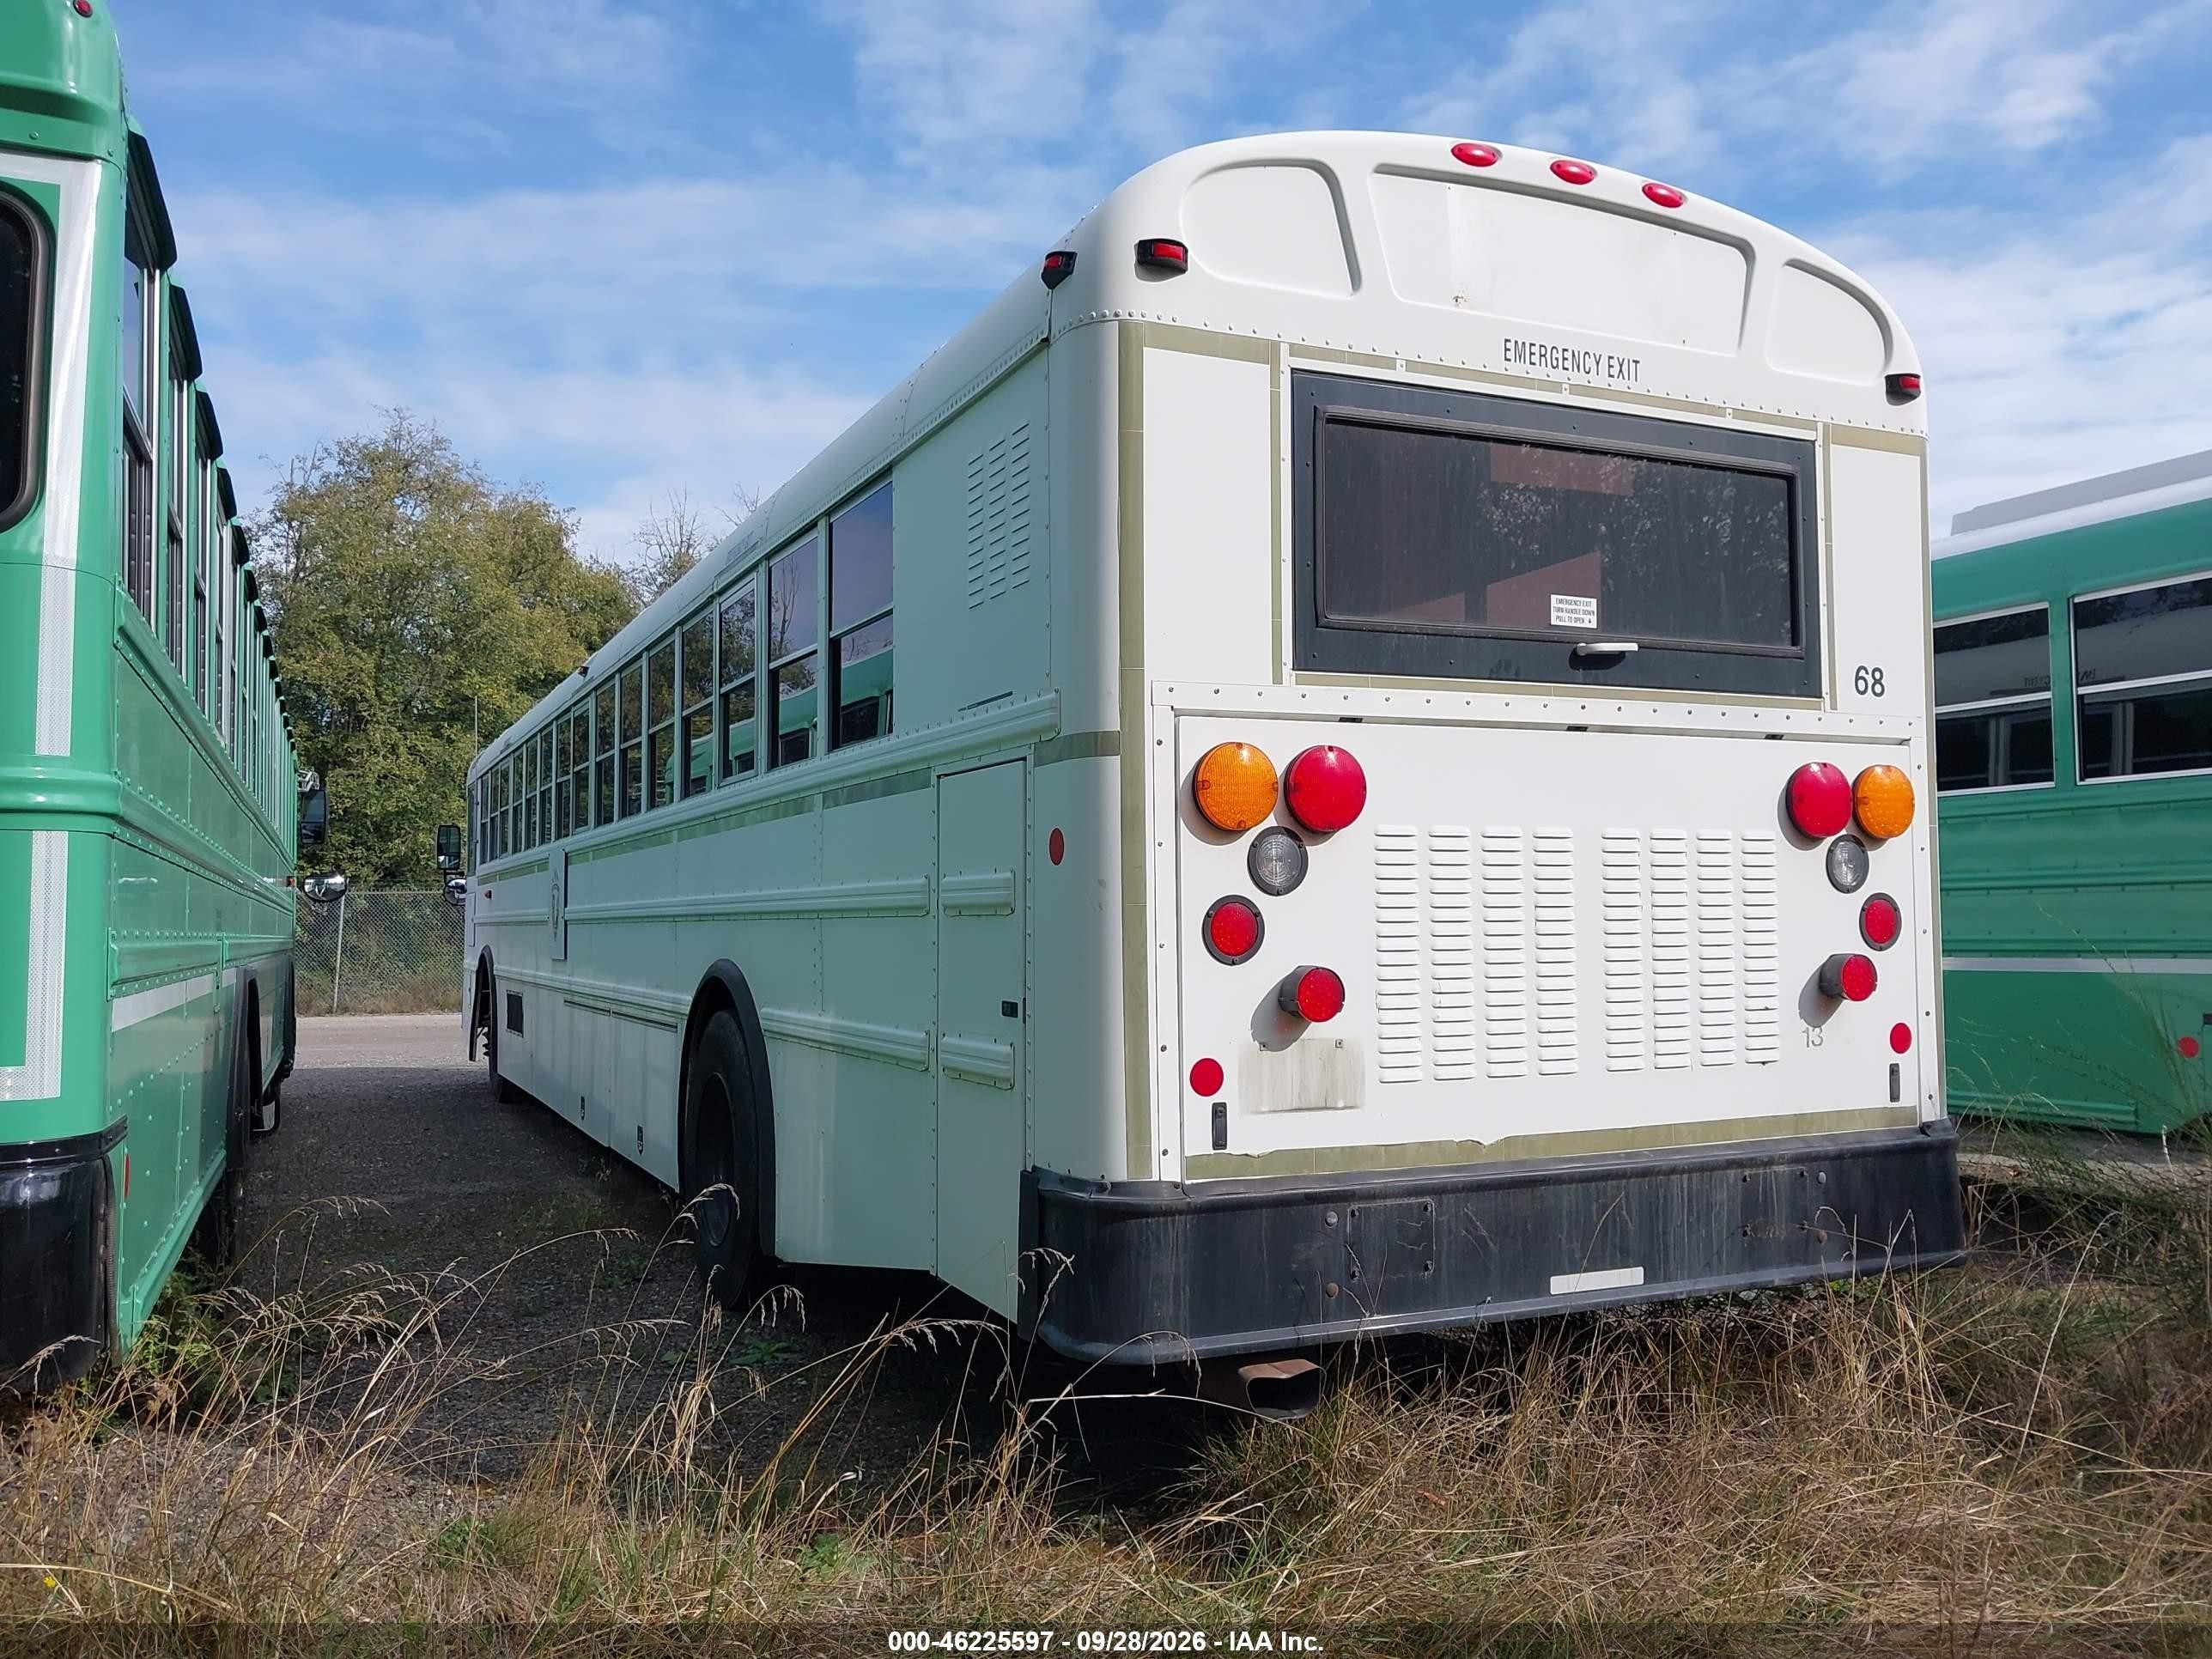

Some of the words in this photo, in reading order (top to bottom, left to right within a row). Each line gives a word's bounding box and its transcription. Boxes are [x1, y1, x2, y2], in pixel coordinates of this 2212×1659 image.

[1504, 338, 1602, 376] EMERGENCY
[1607, 356, 1641, 383] EXIT
[1555, 598, 1582, 607] EMERGENCY
[1855, 665, 1885, 697] 68
[1802, 1026, 1824, 1048] 13
